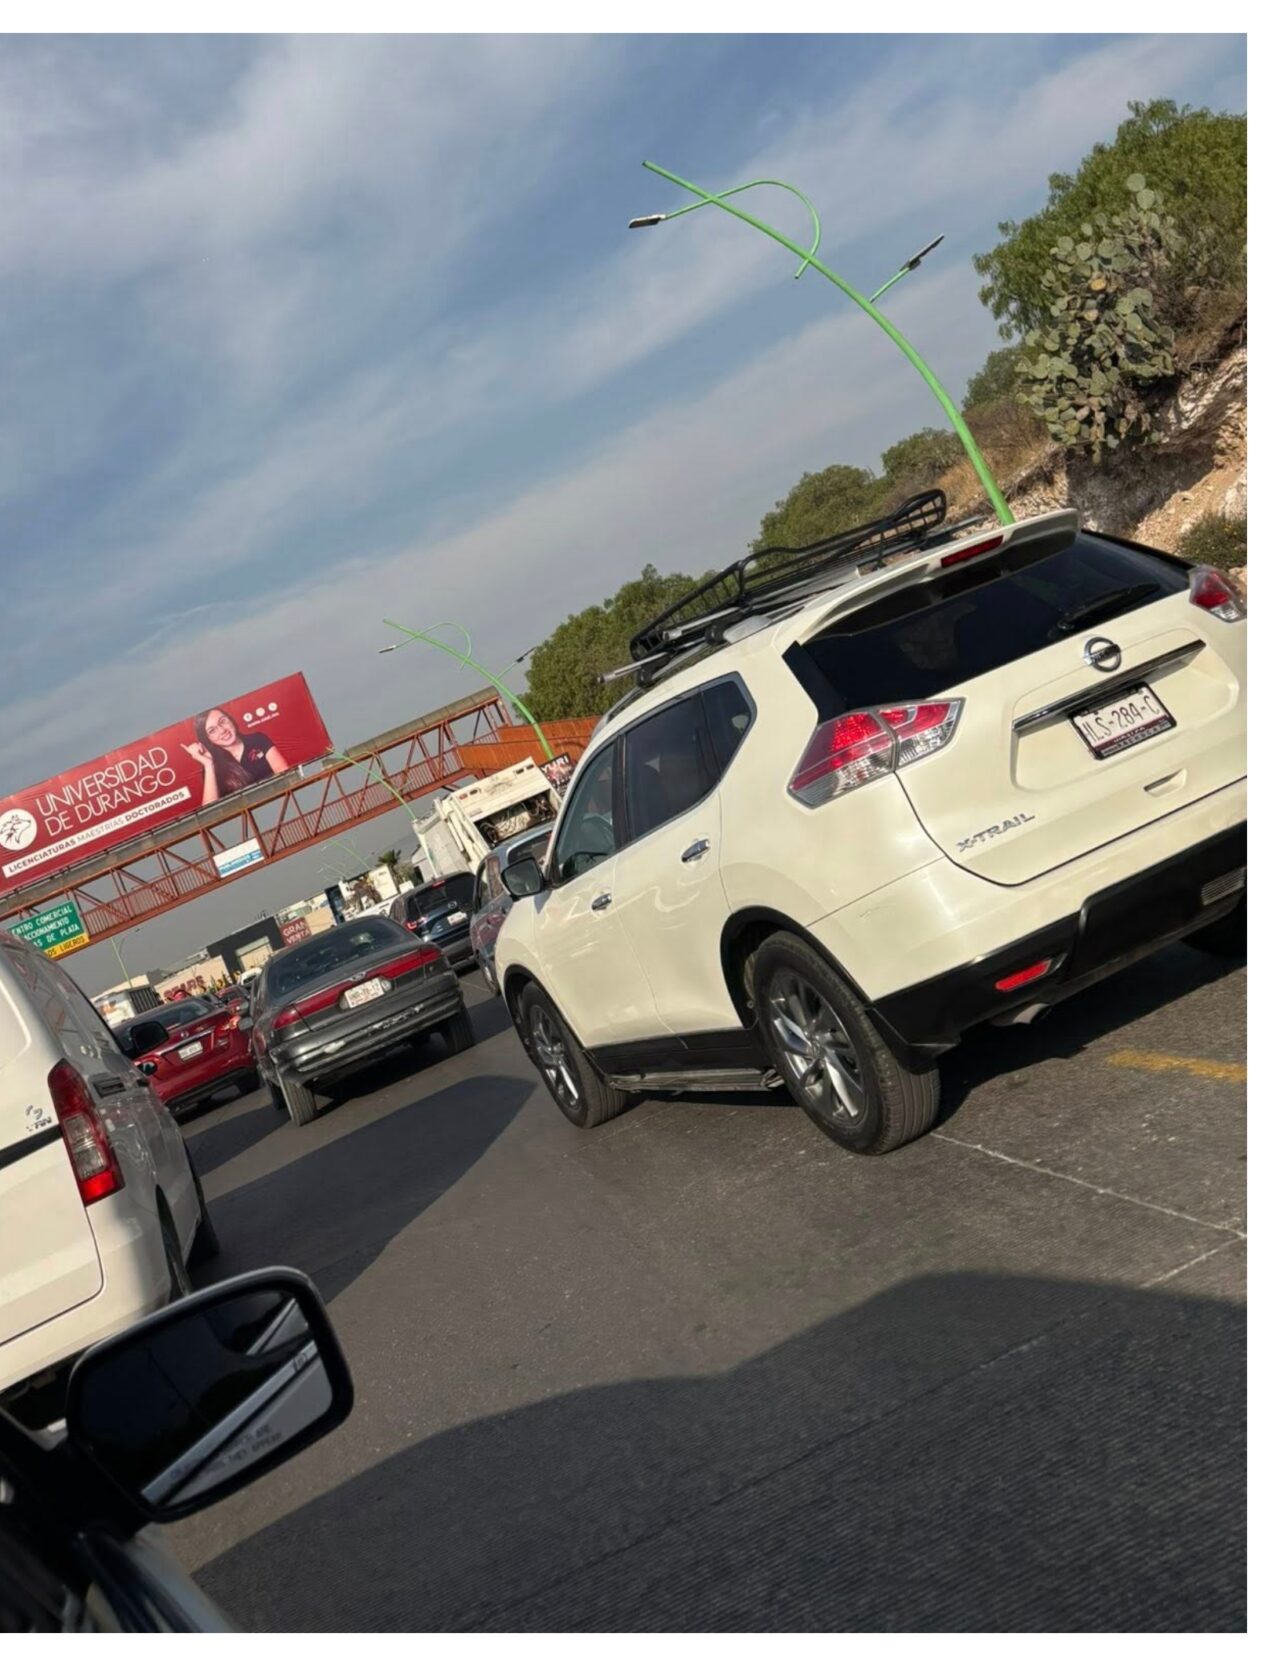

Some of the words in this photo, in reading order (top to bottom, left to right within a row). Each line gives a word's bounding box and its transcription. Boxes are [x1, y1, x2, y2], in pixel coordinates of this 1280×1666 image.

[36, 747, 168, 817] UNIVERSIDAD
[44, 810, 73, 837] DE
[74, 767, 176, 823] DURANGO
[8, 838, 77, 873] LICENCIATURAS
[125, 791, 185, 822] DOCTORADOS
[956, 813, 1036, 853] X-TRAIL
[46, 933, 56, 943] DE
[60, 923, 80, 937] PLATA
